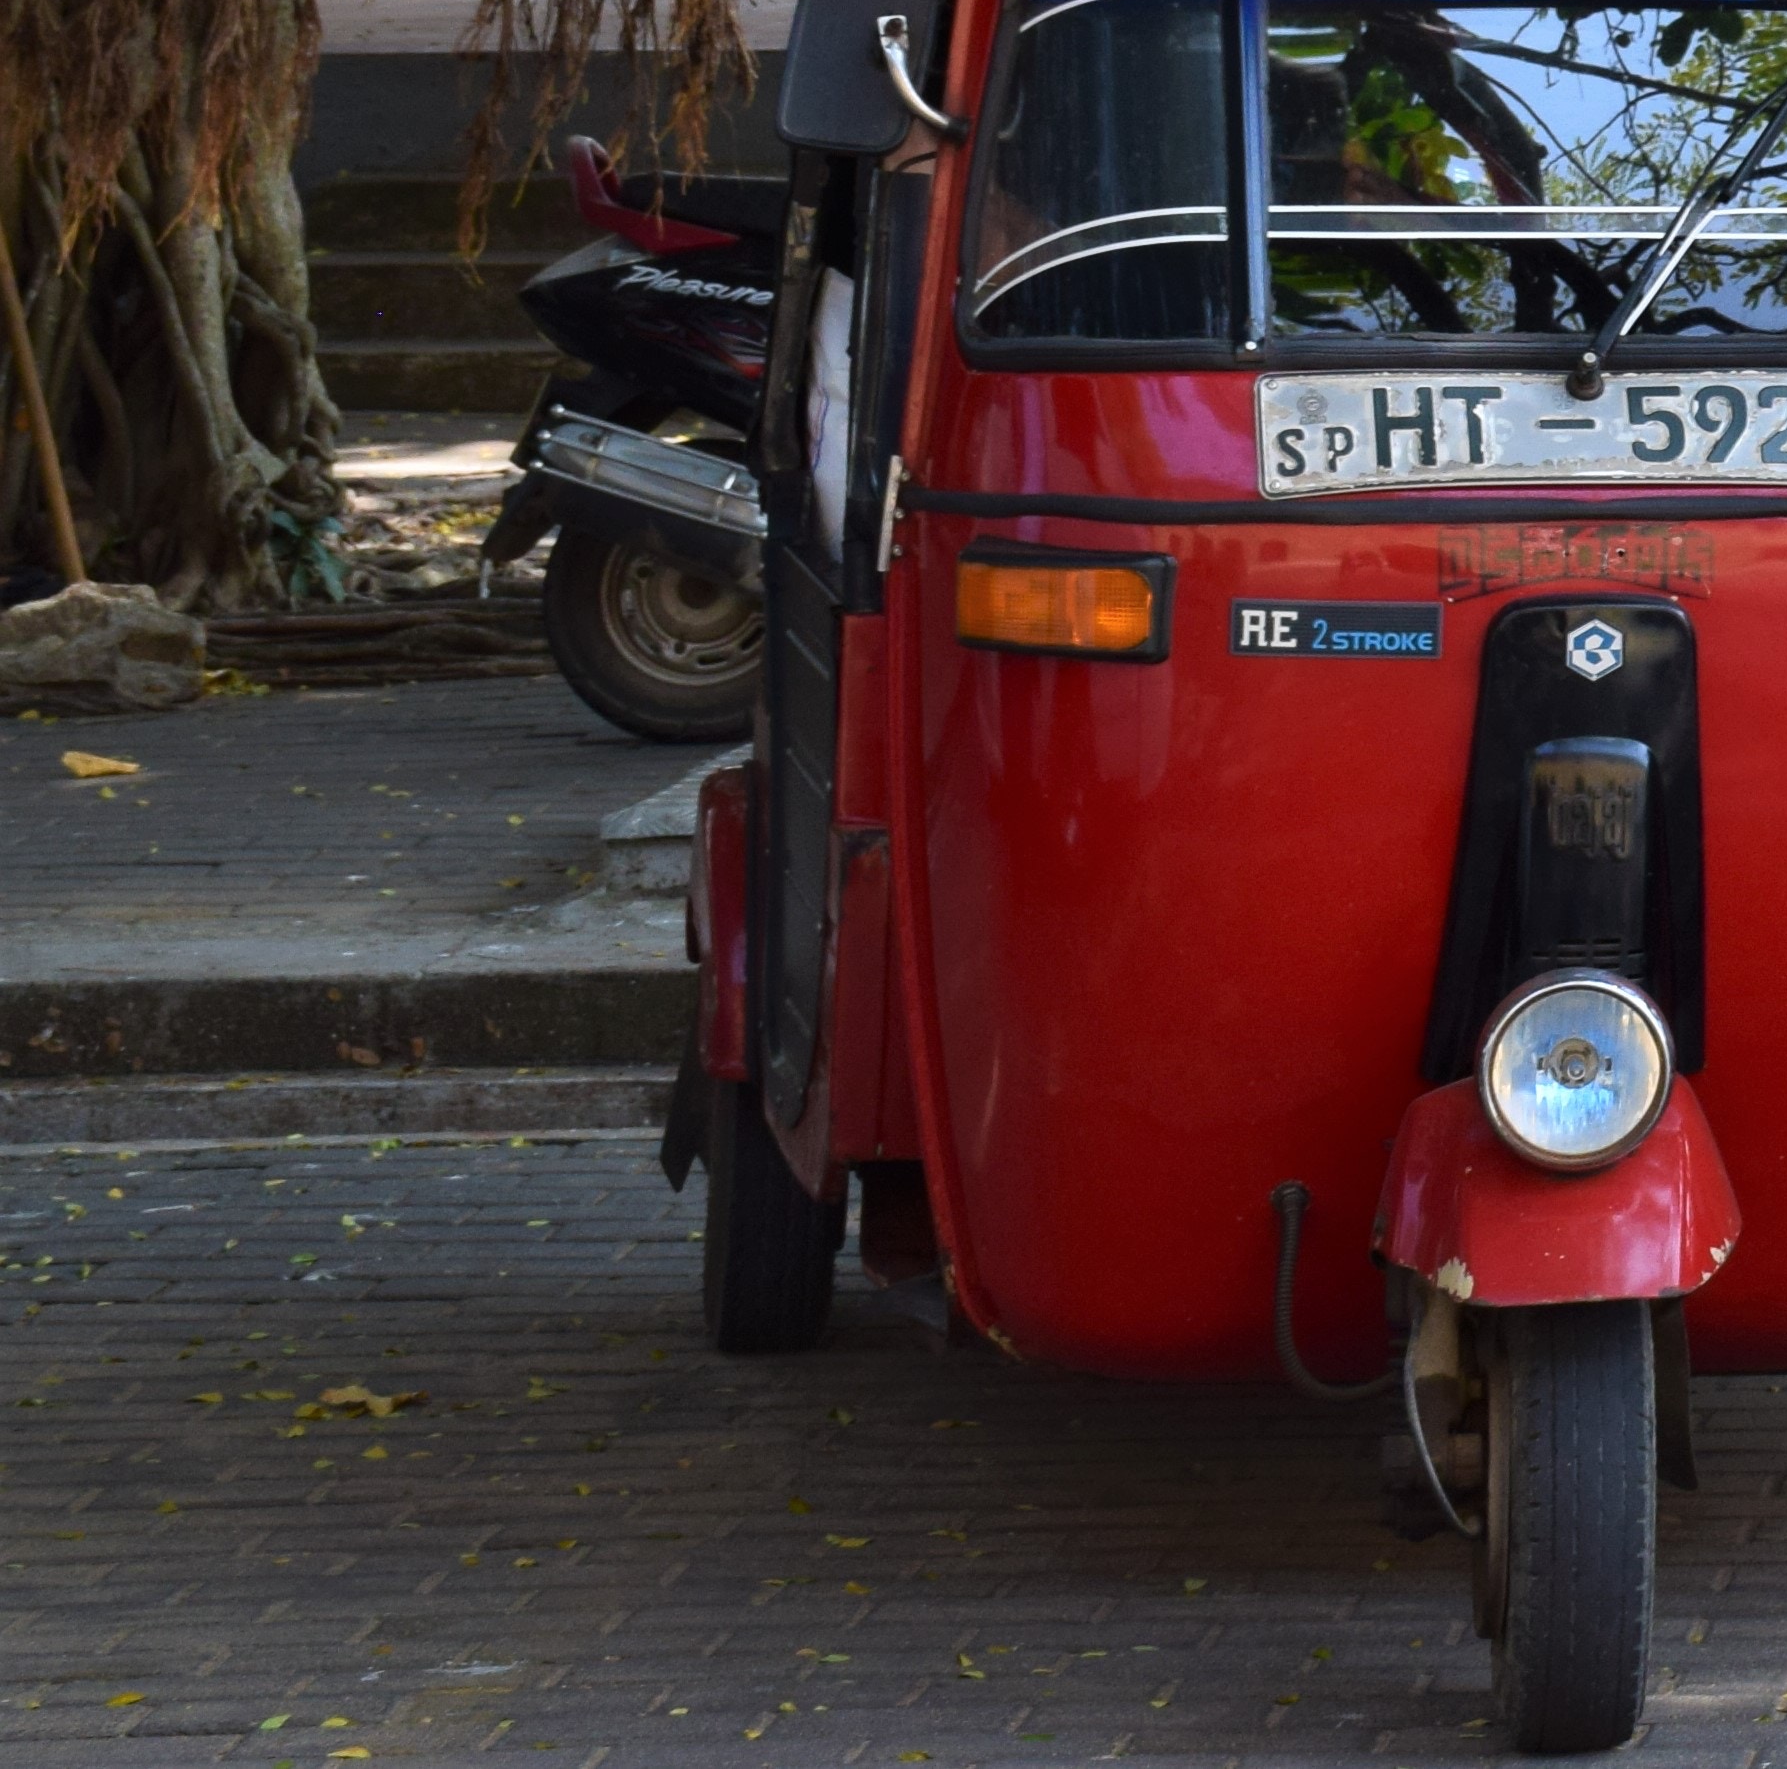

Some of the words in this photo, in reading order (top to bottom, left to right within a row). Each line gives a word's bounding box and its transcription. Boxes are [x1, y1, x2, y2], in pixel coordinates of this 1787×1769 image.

[612, 265, 774, 305] Pleasure
[1276, 425, 1354, 478] SP
[1240, 609, 1298, 648] RE
[1332, 632, 1433, 651] STROKE
